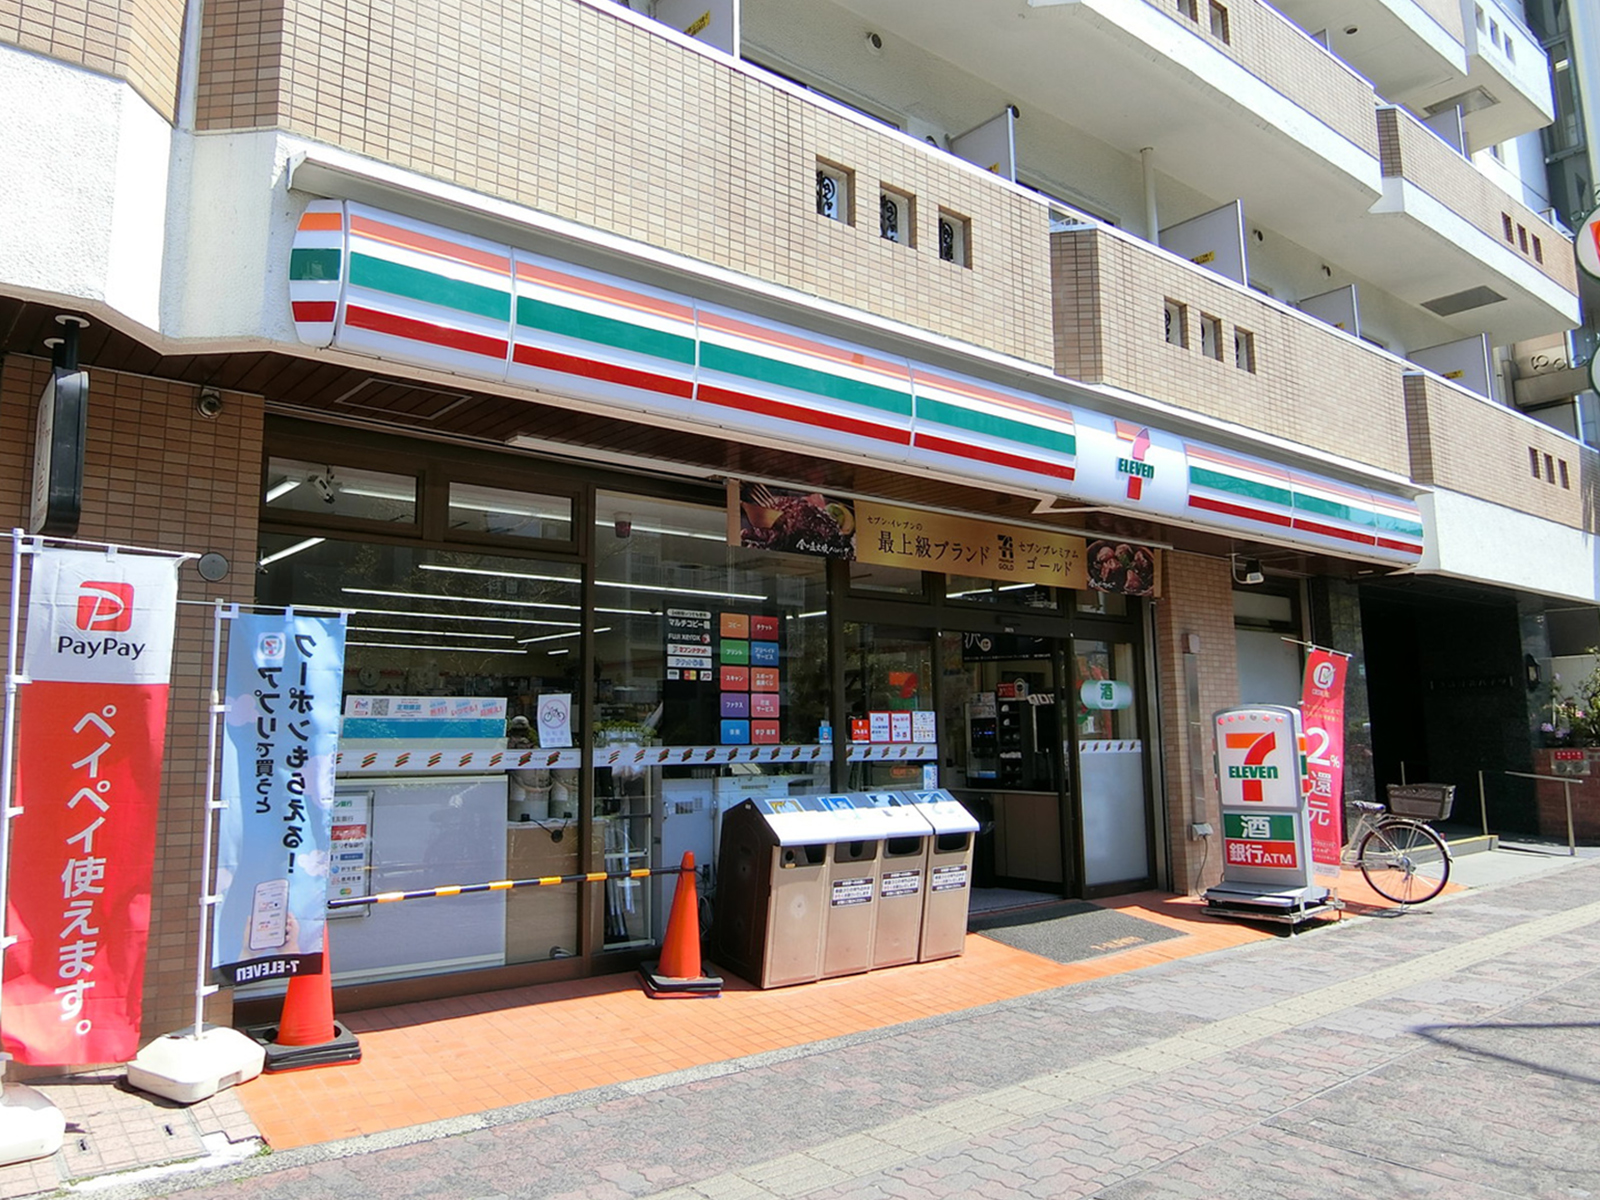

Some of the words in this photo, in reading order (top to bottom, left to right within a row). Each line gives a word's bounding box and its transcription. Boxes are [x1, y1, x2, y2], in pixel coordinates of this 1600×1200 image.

[878, 531, 990, 566] 最上級ブランド
[1018, 541, 1079, 559] セブンプレミアム
[1026, 557, 1073, 577] ゴールド
[57, 635, 146, 660] PayPay
[1100, 683, 1113, 700] 酒
[1240, 815, 1271, 839] 酒
[1229, 843, 1293, 865] 銀行ATM
[54, 704, 117, 1035] ペイペイ使えます。
